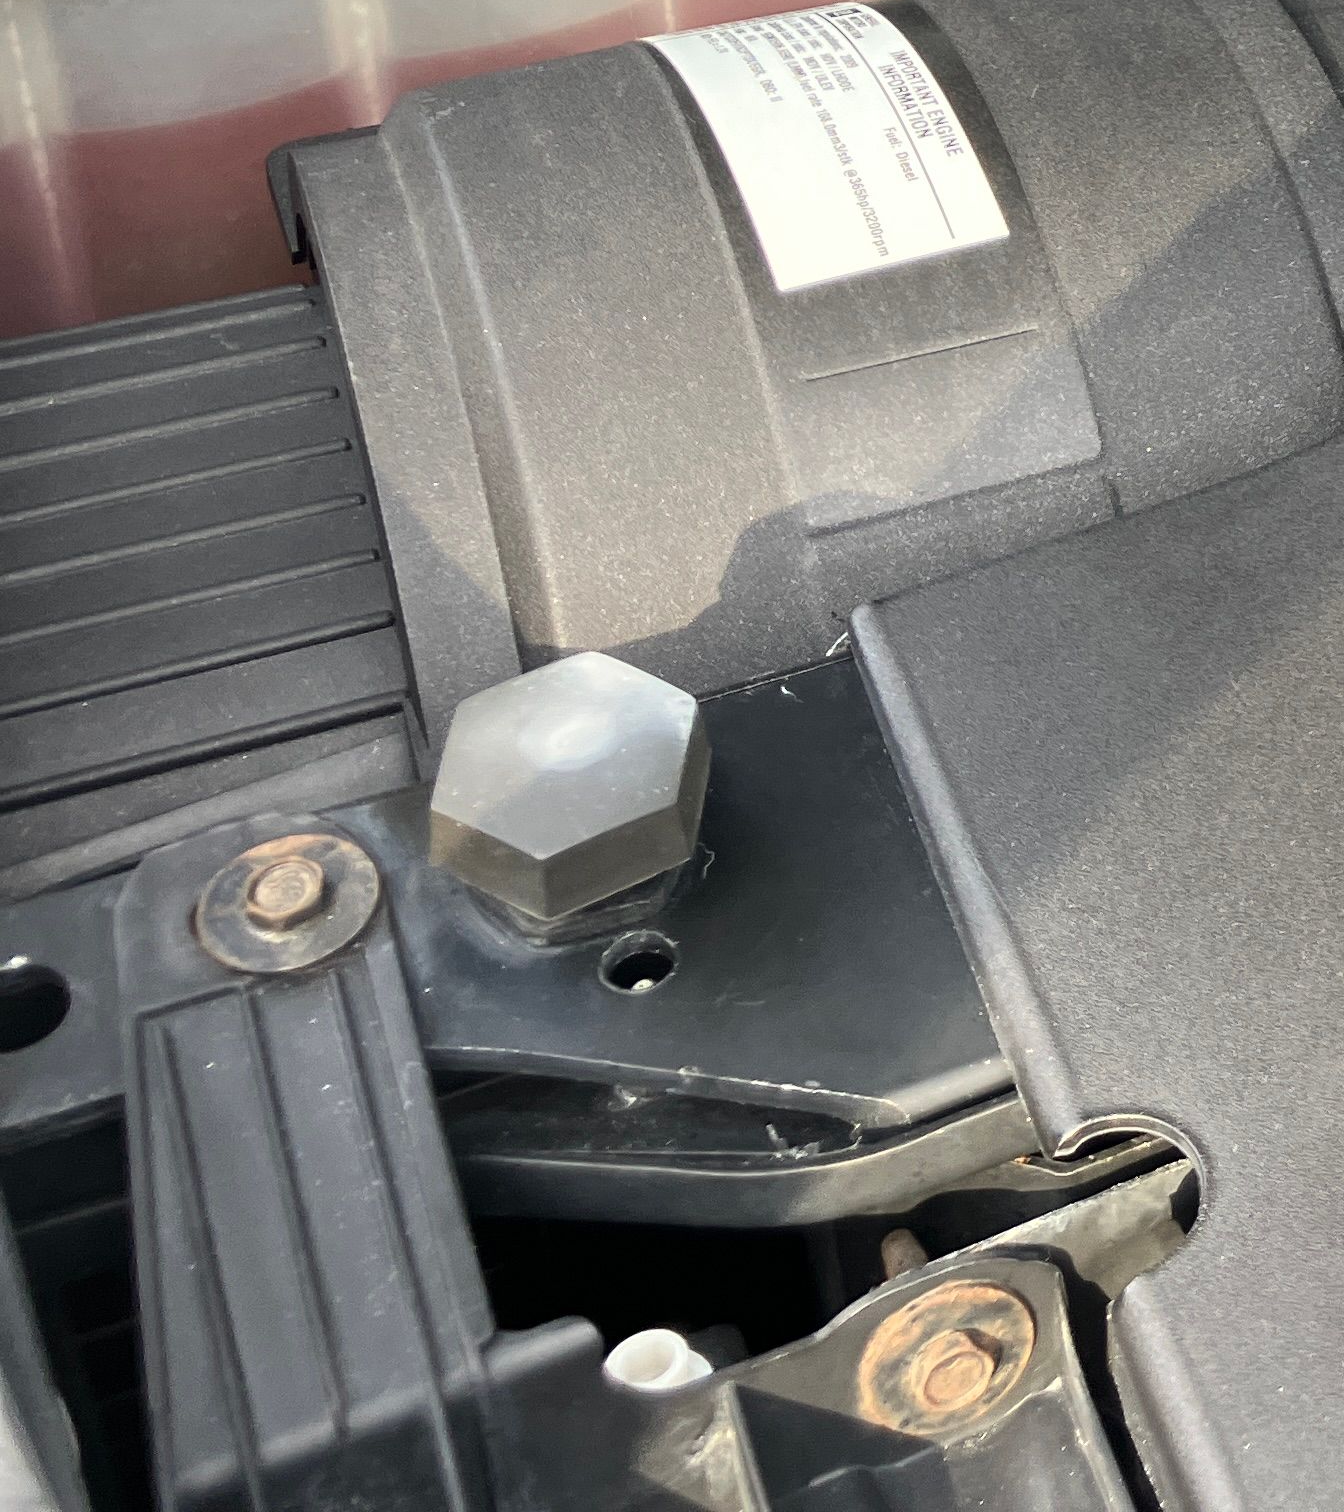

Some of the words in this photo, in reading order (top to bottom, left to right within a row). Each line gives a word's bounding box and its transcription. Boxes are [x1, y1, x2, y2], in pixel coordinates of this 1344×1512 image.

[878, 63, 935, 140] INFORMATION
[889, 49, 939, 106] IMPORTANT
[926, 108, 965, 157] ENGINE
[883, 126, 902, 149] Fuel:
[895, 151, 919, 182] Diesel
